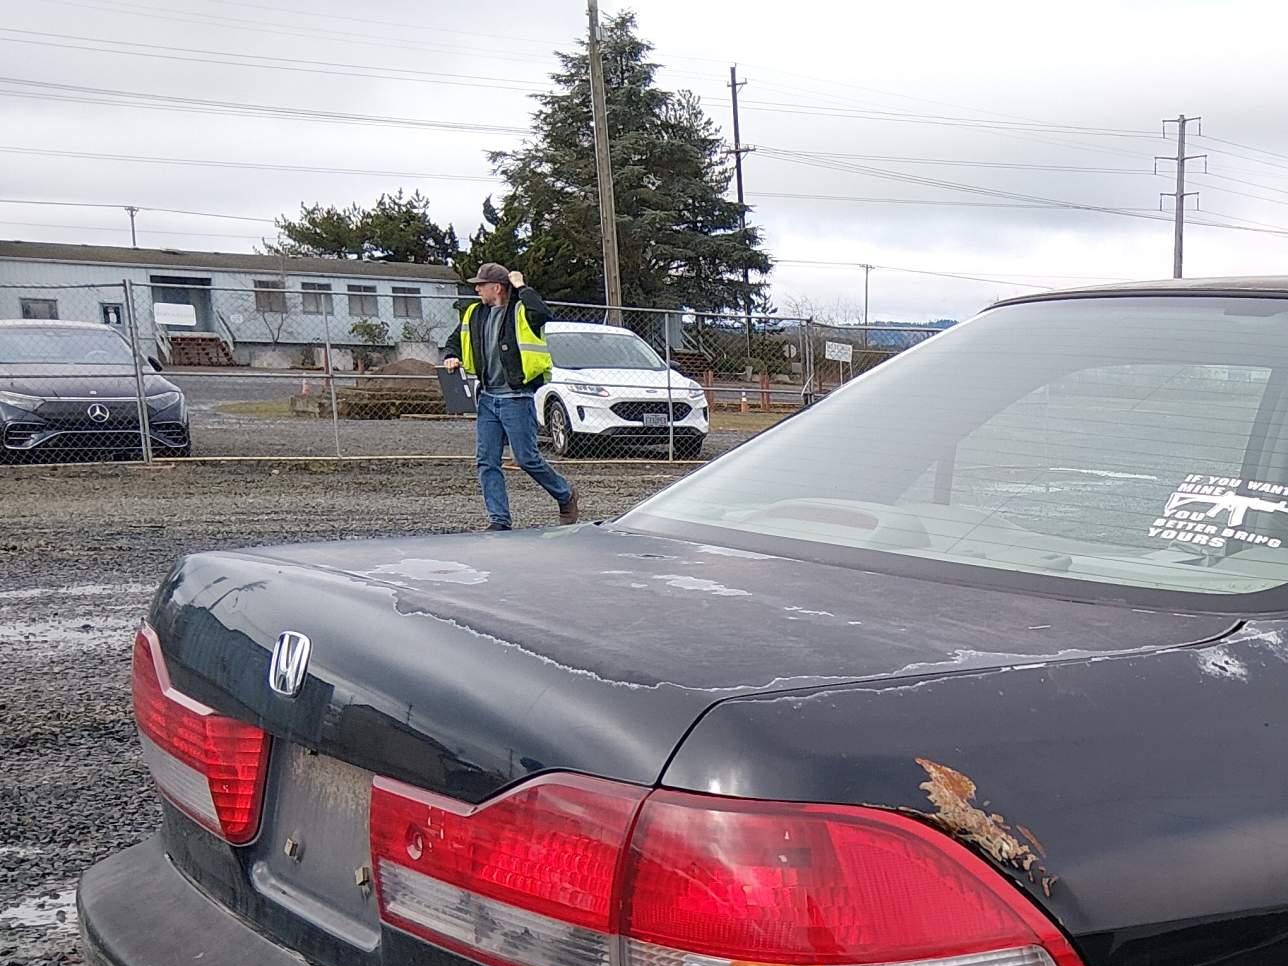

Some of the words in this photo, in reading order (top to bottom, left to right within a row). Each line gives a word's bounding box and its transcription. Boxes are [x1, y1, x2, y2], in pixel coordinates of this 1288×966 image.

[1184, 474, 1204, 483] IF
[1208, 476, 1242, 488] YOU
[1177, 483, 1226, 496] MINE
[1163, 508, 1206, 522] YOU
[1147, 527, 1226, 548] YOURS
[1152, 518, 1218, 535] BETTER
[1220, 528, 1282, 548] BRING
